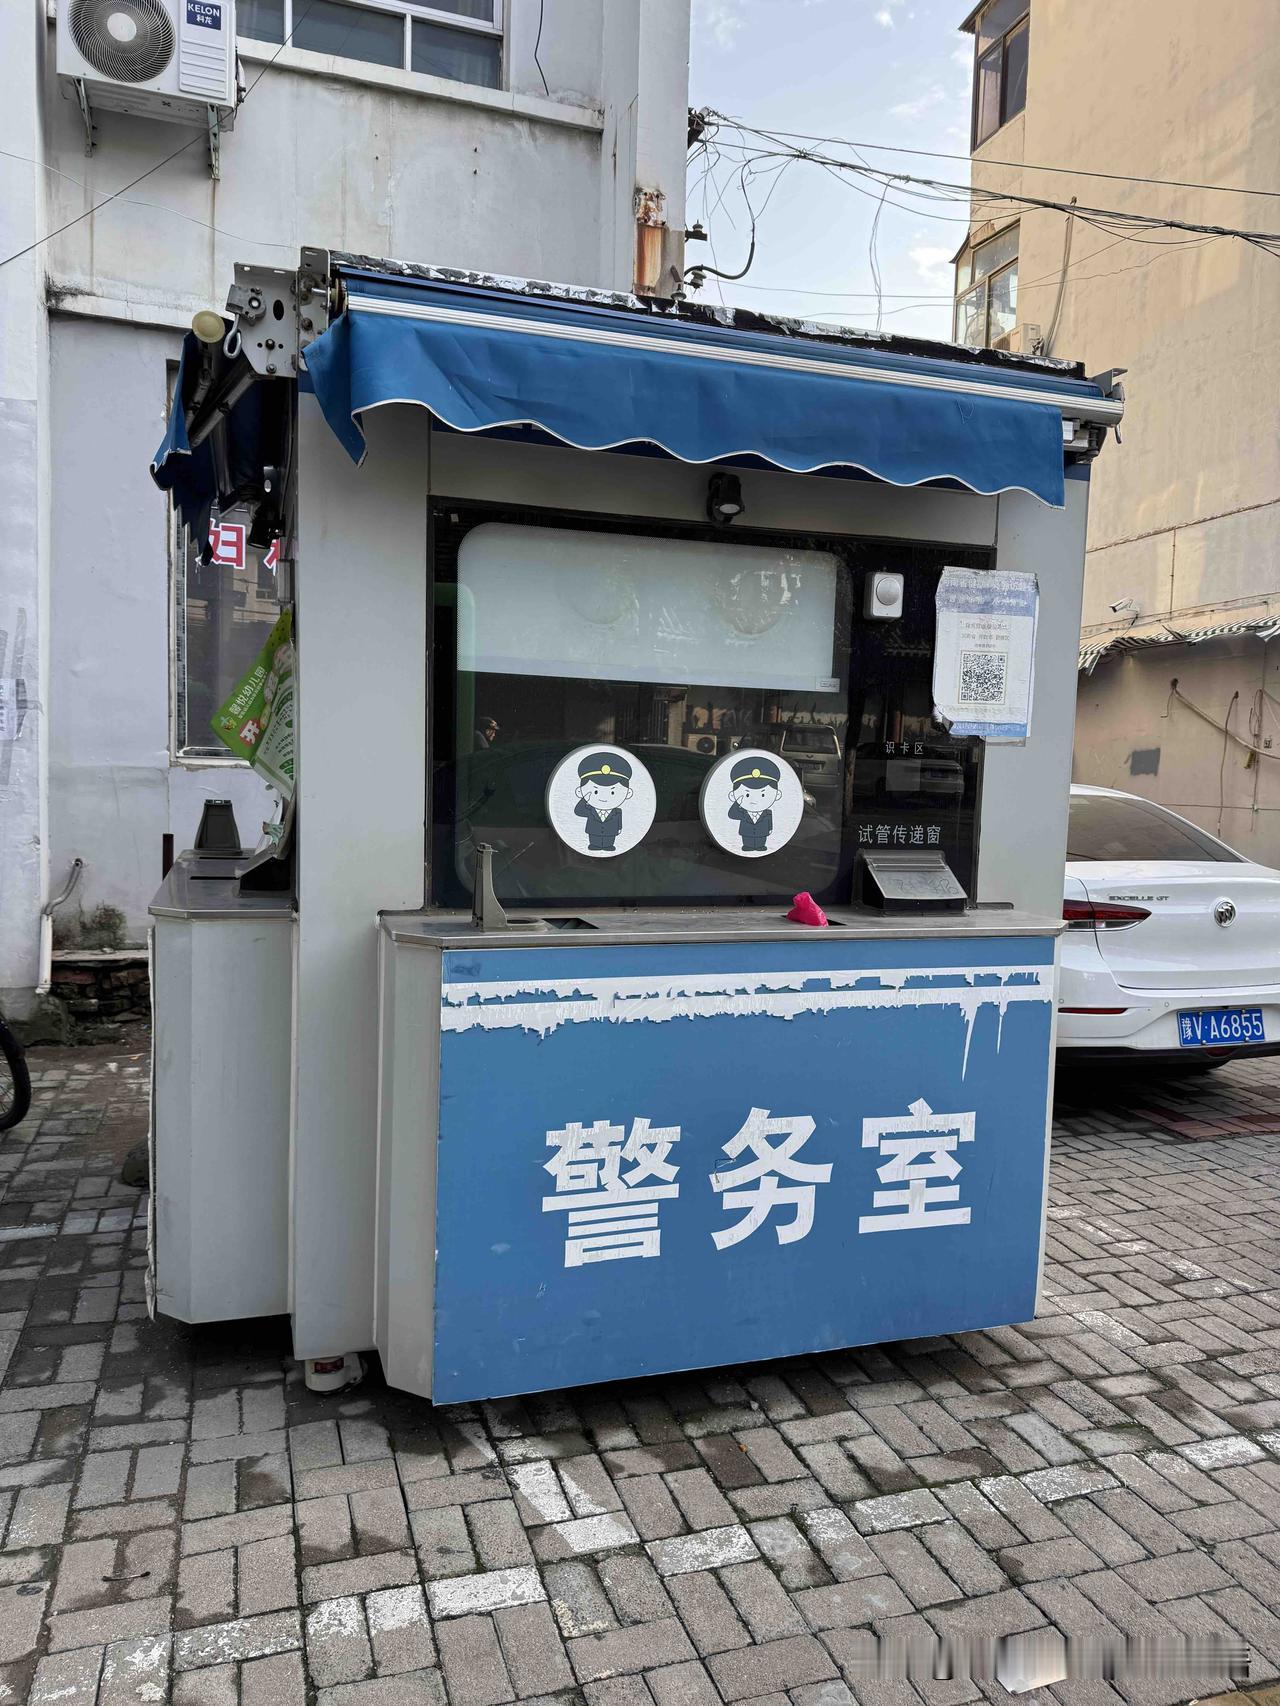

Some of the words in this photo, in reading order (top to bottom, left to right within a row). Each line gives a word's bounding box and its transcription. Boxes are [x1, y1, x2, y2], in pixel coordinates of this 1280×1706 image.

[188, 3, 220, 16] KELON
[196, 14, 212, 24] 科龙
[885, 740, 925, 755] 识卡区
[858, 824, 942, 845] 试管传递窗
[541, 1097, 977, 1269] 警务室
